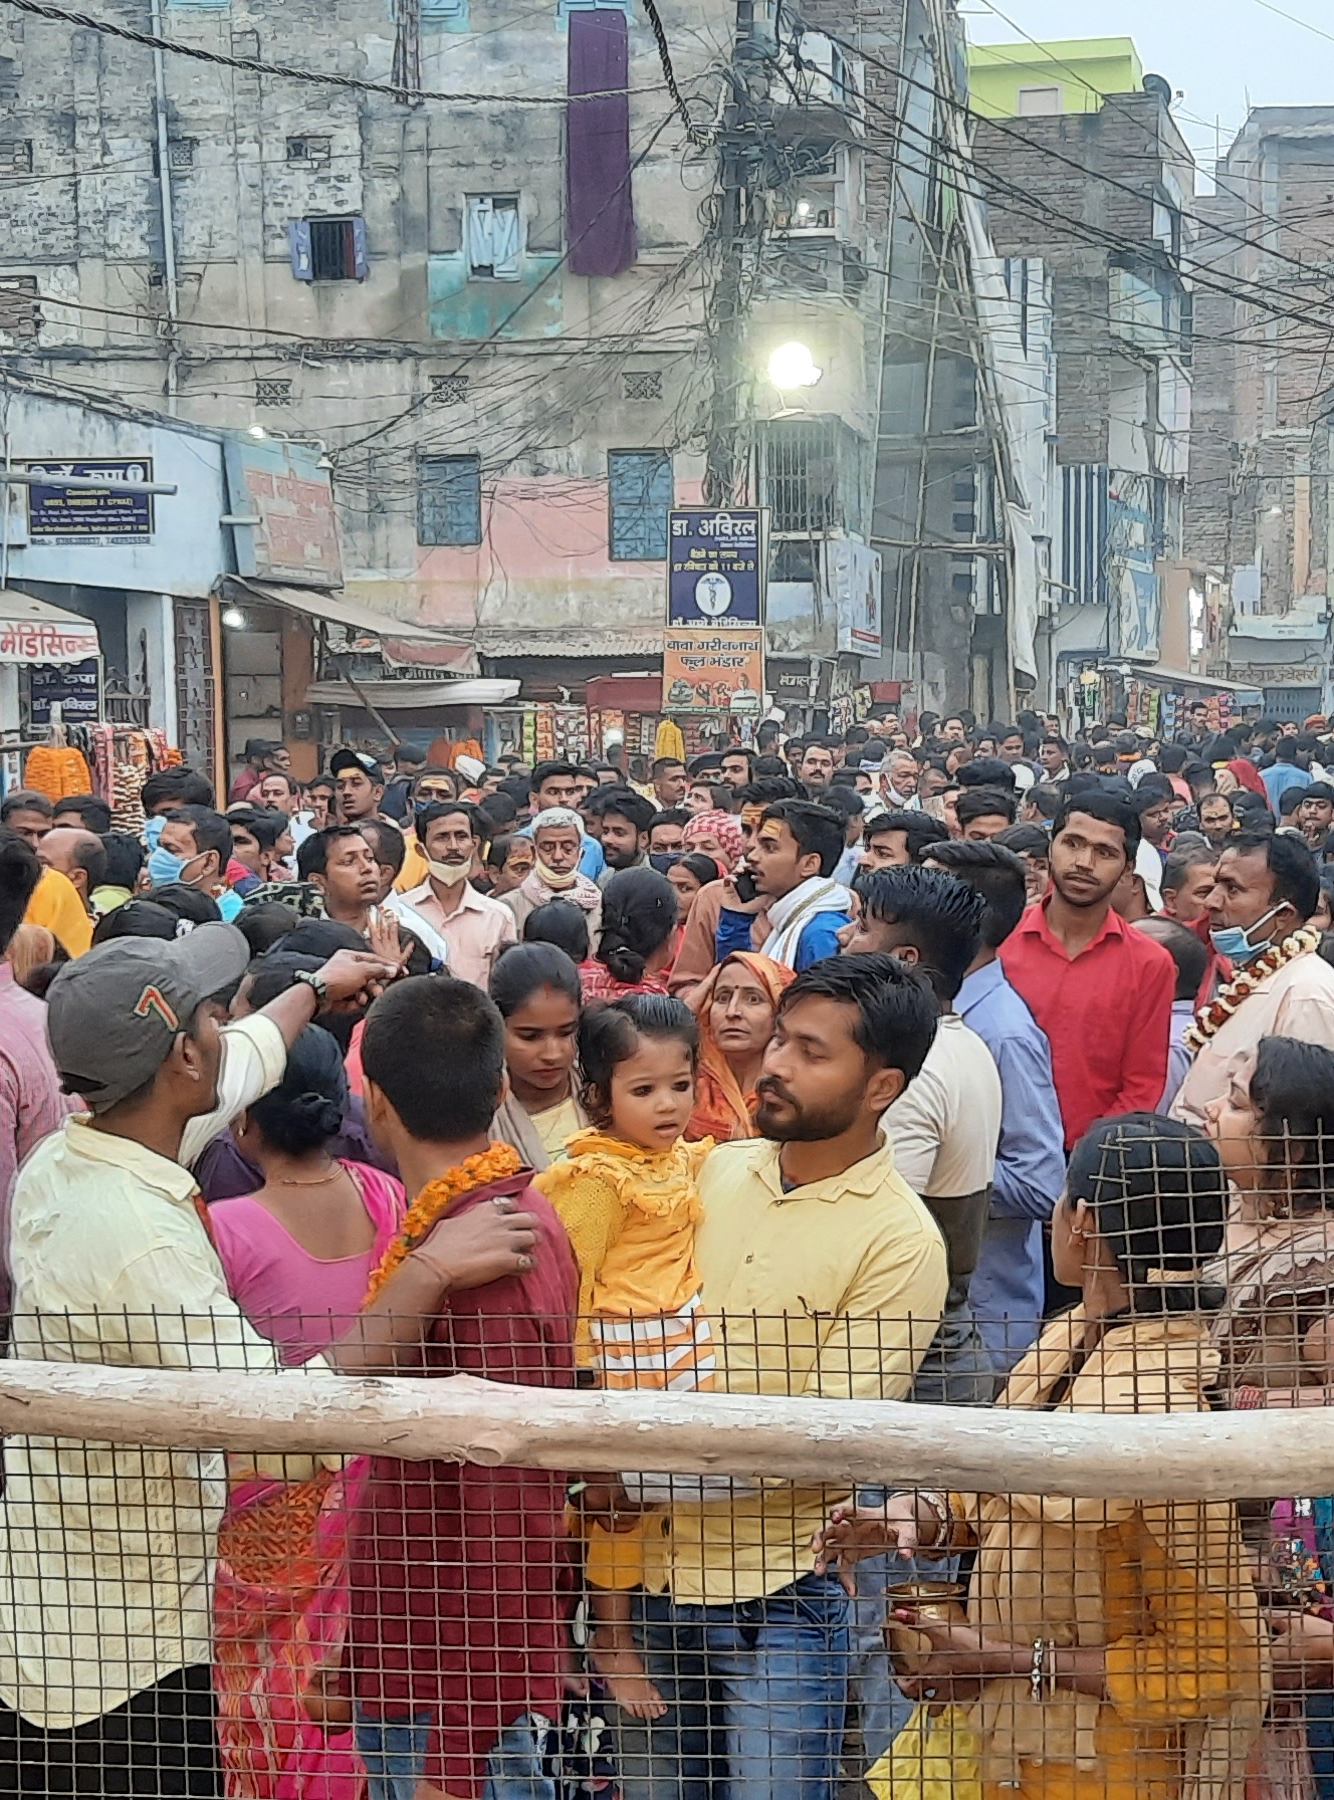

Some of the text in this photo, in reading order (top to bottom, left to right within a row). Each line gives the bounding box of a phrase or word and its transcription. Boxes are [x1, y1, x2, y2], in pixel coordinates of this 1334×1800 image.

[698, 513, 757, 536] अविरल
[710, 653, 746, 669] भंडार
[133, 984, 180, 1032] 7
